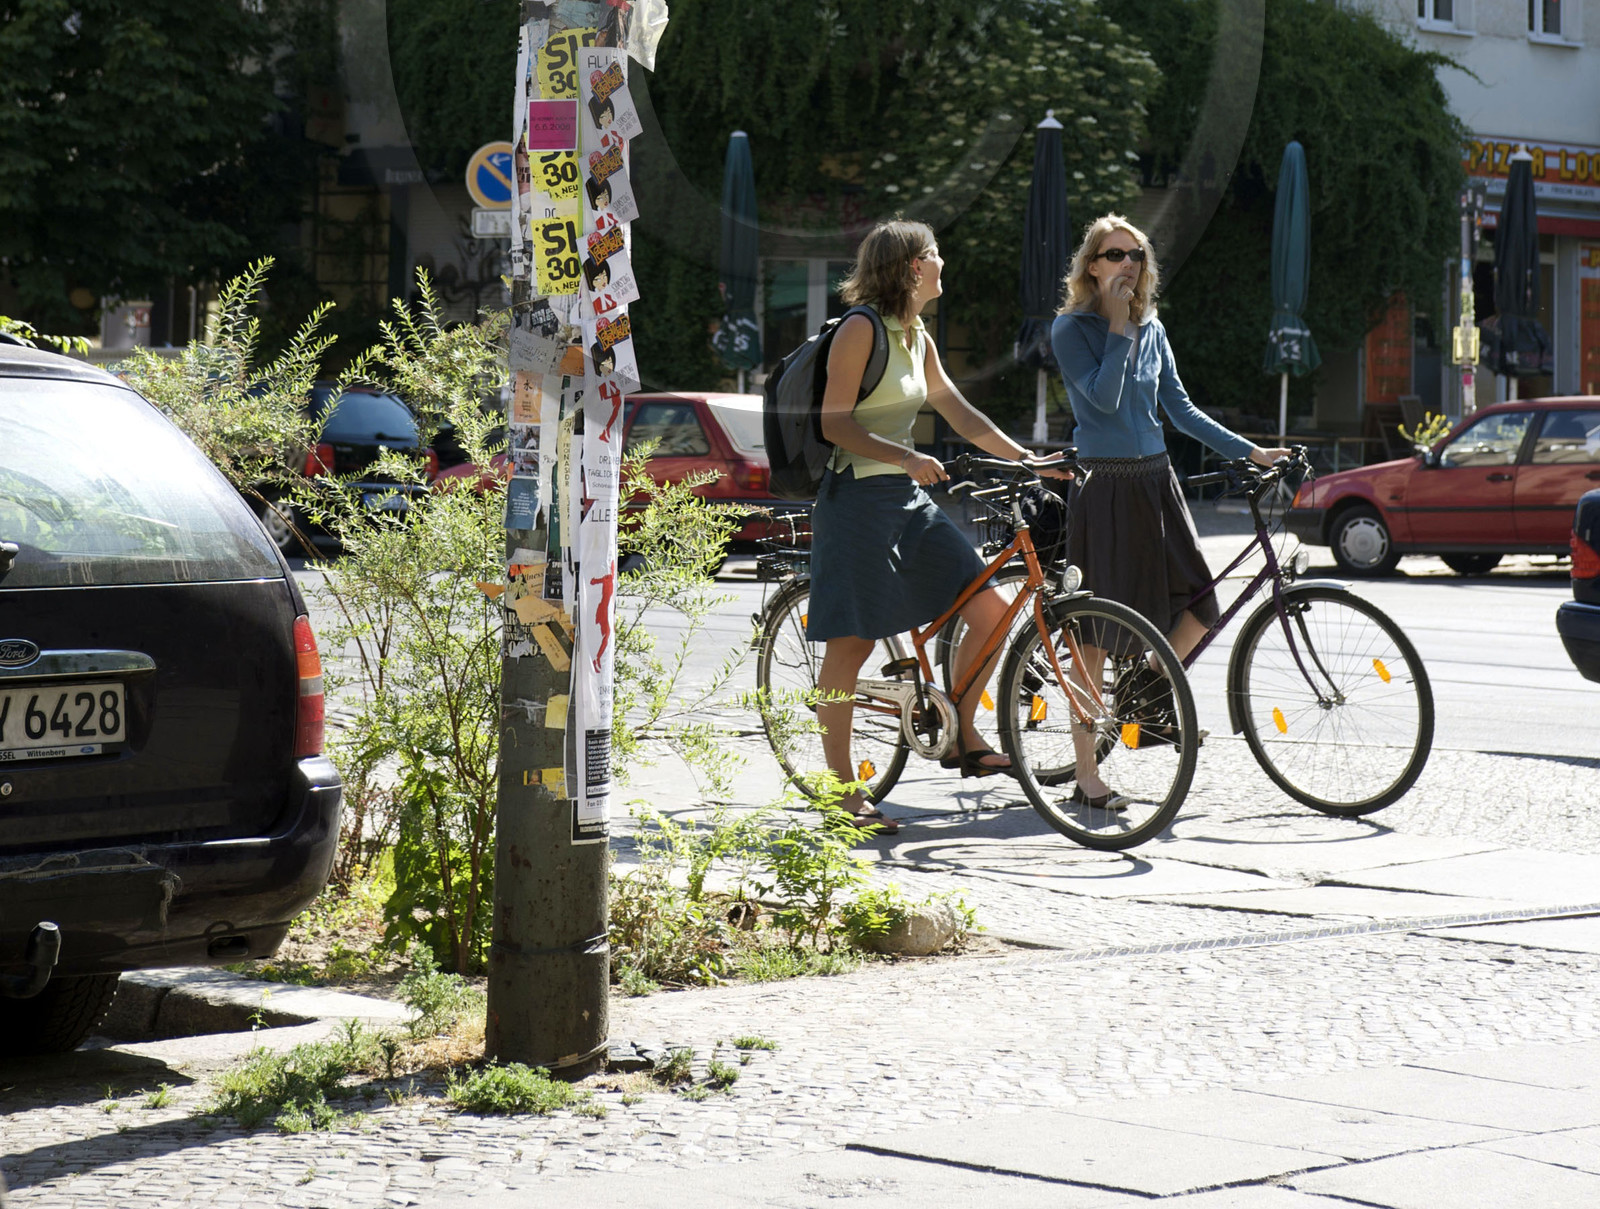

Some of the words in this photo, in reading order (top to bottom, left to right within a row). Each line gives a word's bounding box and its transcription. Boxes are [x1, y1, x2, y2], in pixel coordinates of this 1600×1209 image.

[542, 161, 578, 187] 30
[546, 256, 581, 281] 30
[0, 643, 27, 659] Ford
[24, 690, 120, 740] 6428
[27, 749, 66, 758] Wittenberg
